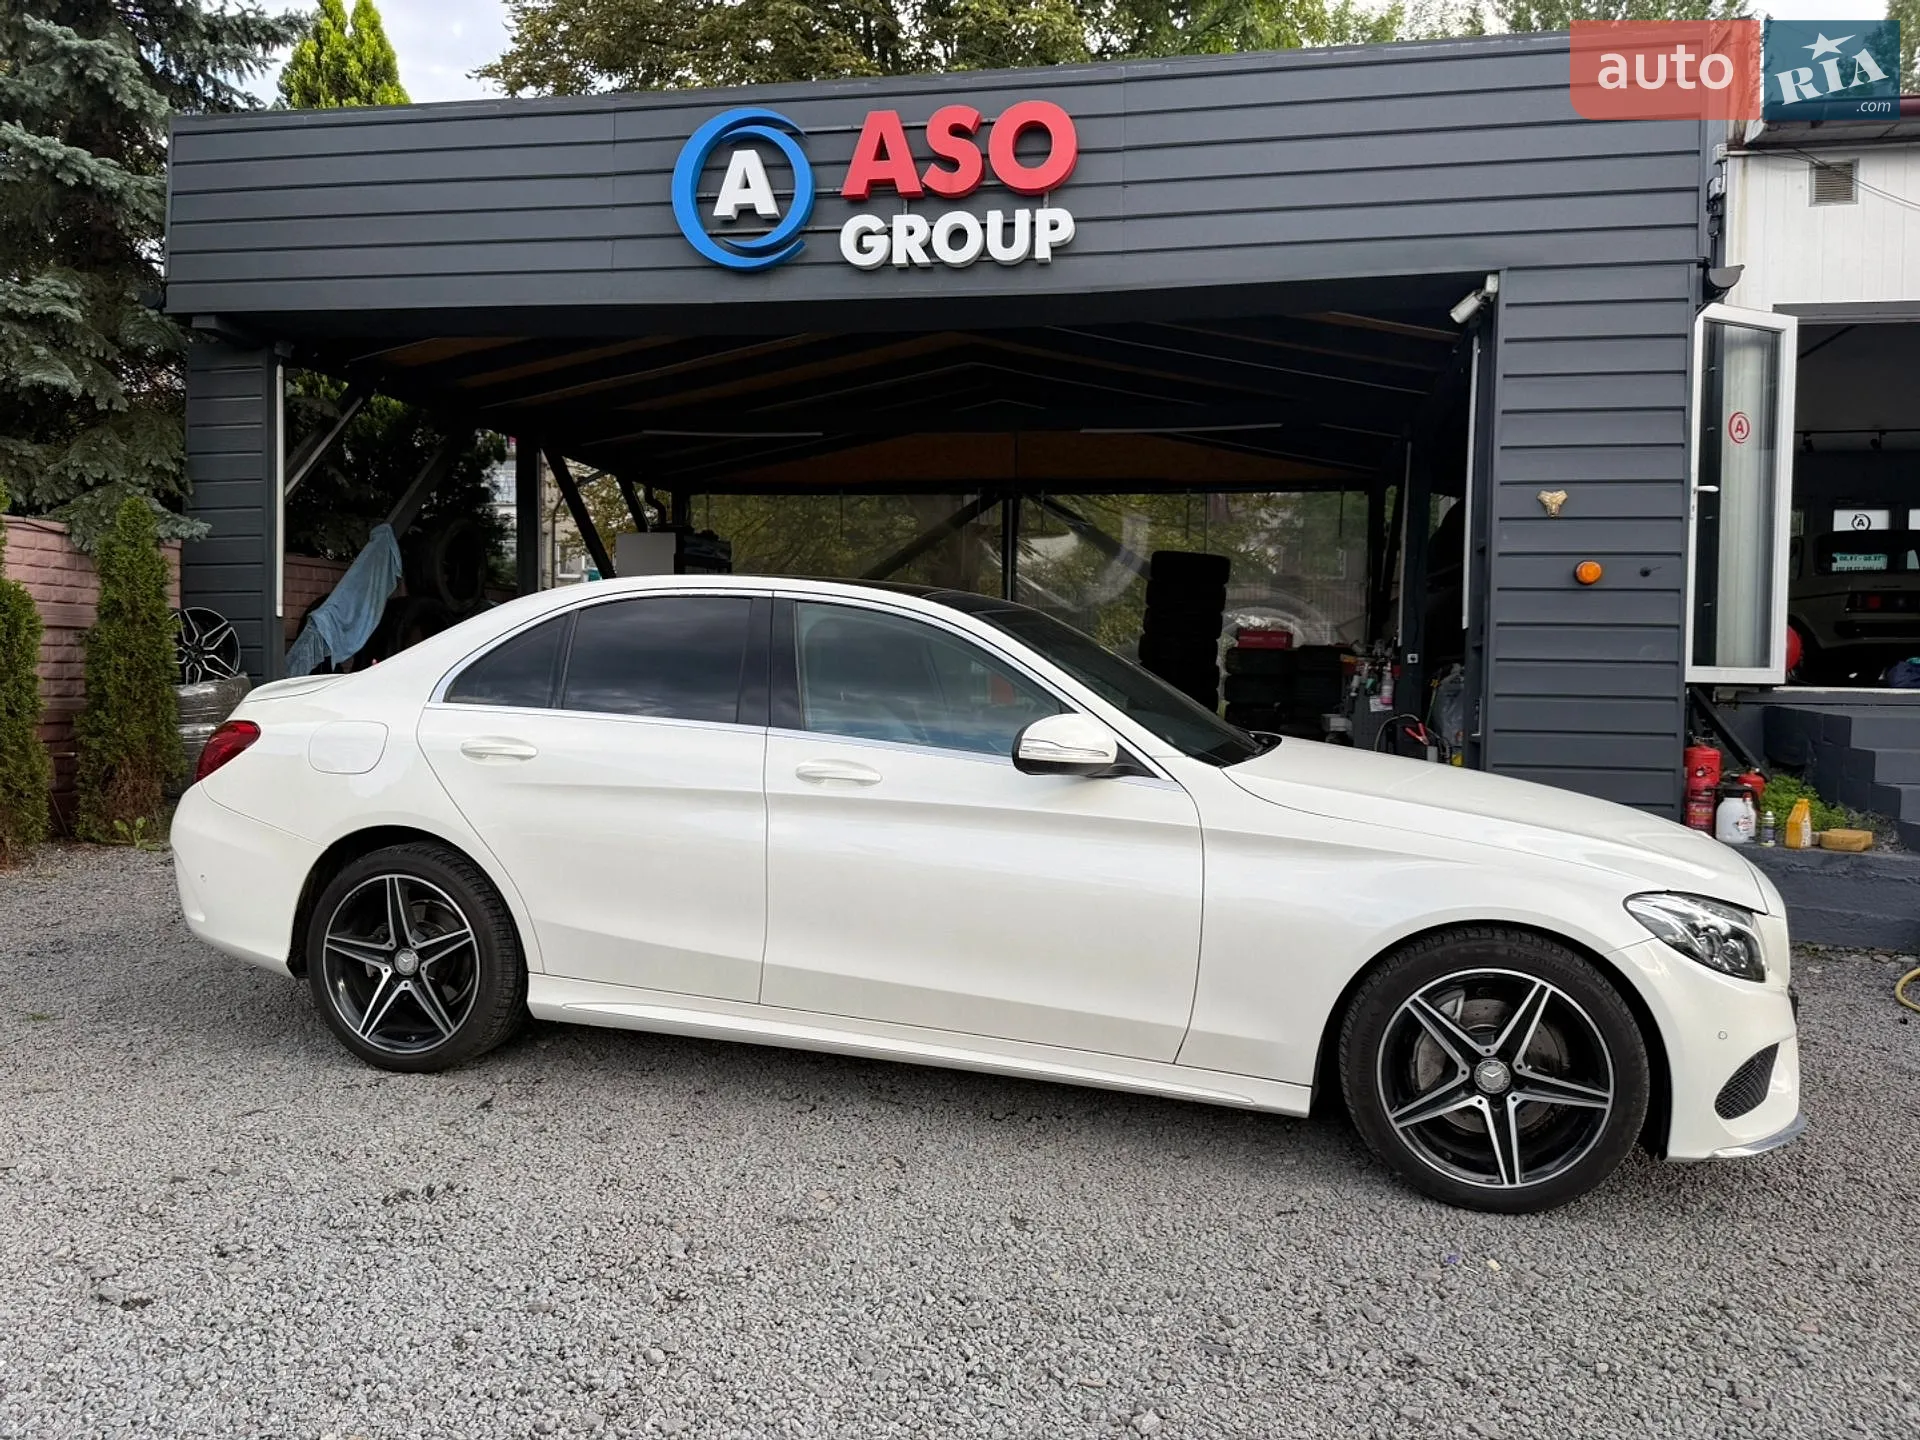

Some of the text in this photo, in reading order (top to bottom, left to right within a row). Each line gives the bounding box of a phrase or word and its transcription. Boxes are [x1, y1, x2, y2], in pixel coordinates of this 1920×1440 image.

[713, 149, 780, 222] A
[840, 100, 1079, 199] ASO
[839, 207, 1076, 271] GROUP
